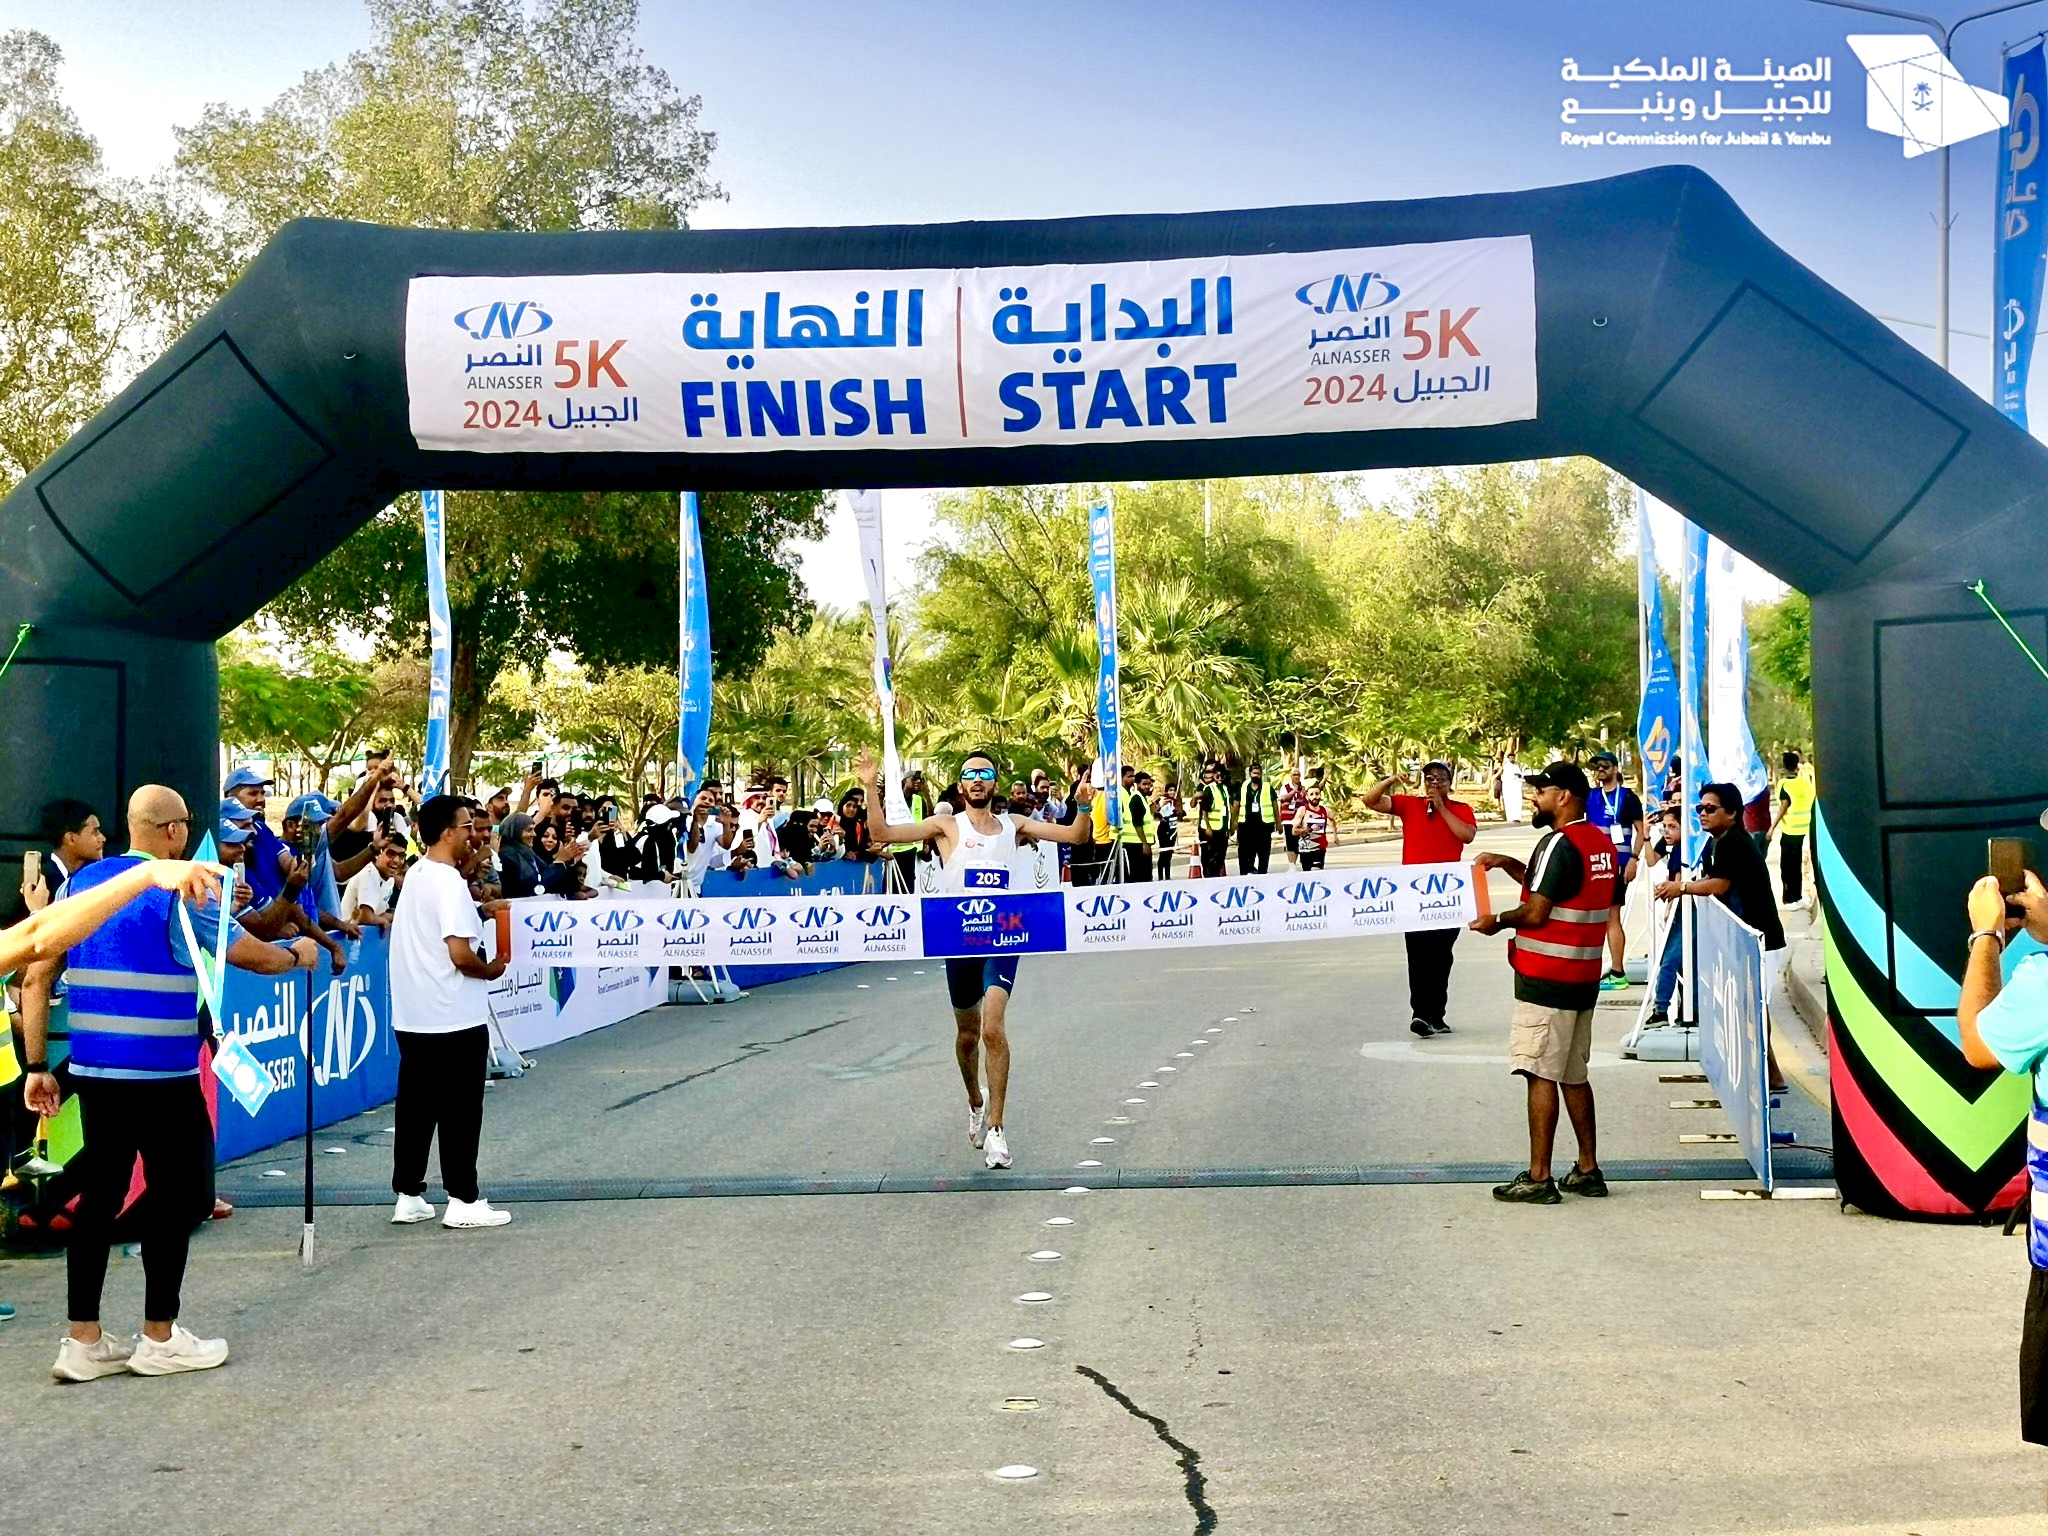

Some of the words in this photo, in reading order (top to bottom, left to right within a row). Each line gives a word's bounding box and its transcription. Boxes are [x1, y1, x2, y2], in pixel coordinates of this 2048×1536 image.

[992, 275, 1237, 364] البداية
[682, 288, 924, 371] النهاية
[1307, 314, 1391, 349] النصر
[1402, 306, 1481, 361] 5K
[464, 342, 543, 374] النصر
[553, 339, 629, 389] 5K
[1309, 348, 1391, 366] ALNASSER
[466, 375, 543, 390] ALNASSER
[1303, 373, 1388, 406] 2024
[1393, 365, 1491, 403] الجبيل
[998, 362, 1238, 433] START
[463, 399, 543, 430] 2024
[547, 396, 639, 430] الجبيل
[681, 378, 927, 438] FINISH
[976, 872, 1001, 886] 205
[1351, 900, 1395, 917] النصر
[1418, 895, 1462, 911] النصر
[1150, 914, 1194, 930] النصر
[1217, 909, 1261, 927] النصر
[1284, 904, 1328, 922] النصر
[863, 927, 906, 944] النصر
[1082, 919, 1127, 935] النصر
[530, 933, 573, 949] النصر
[596, 932, 639, 949] النصر
[662, 932, 706, 949] النصر
[729, 931, 773, 947] النصر
[796, 930, 839, 946] النصر
